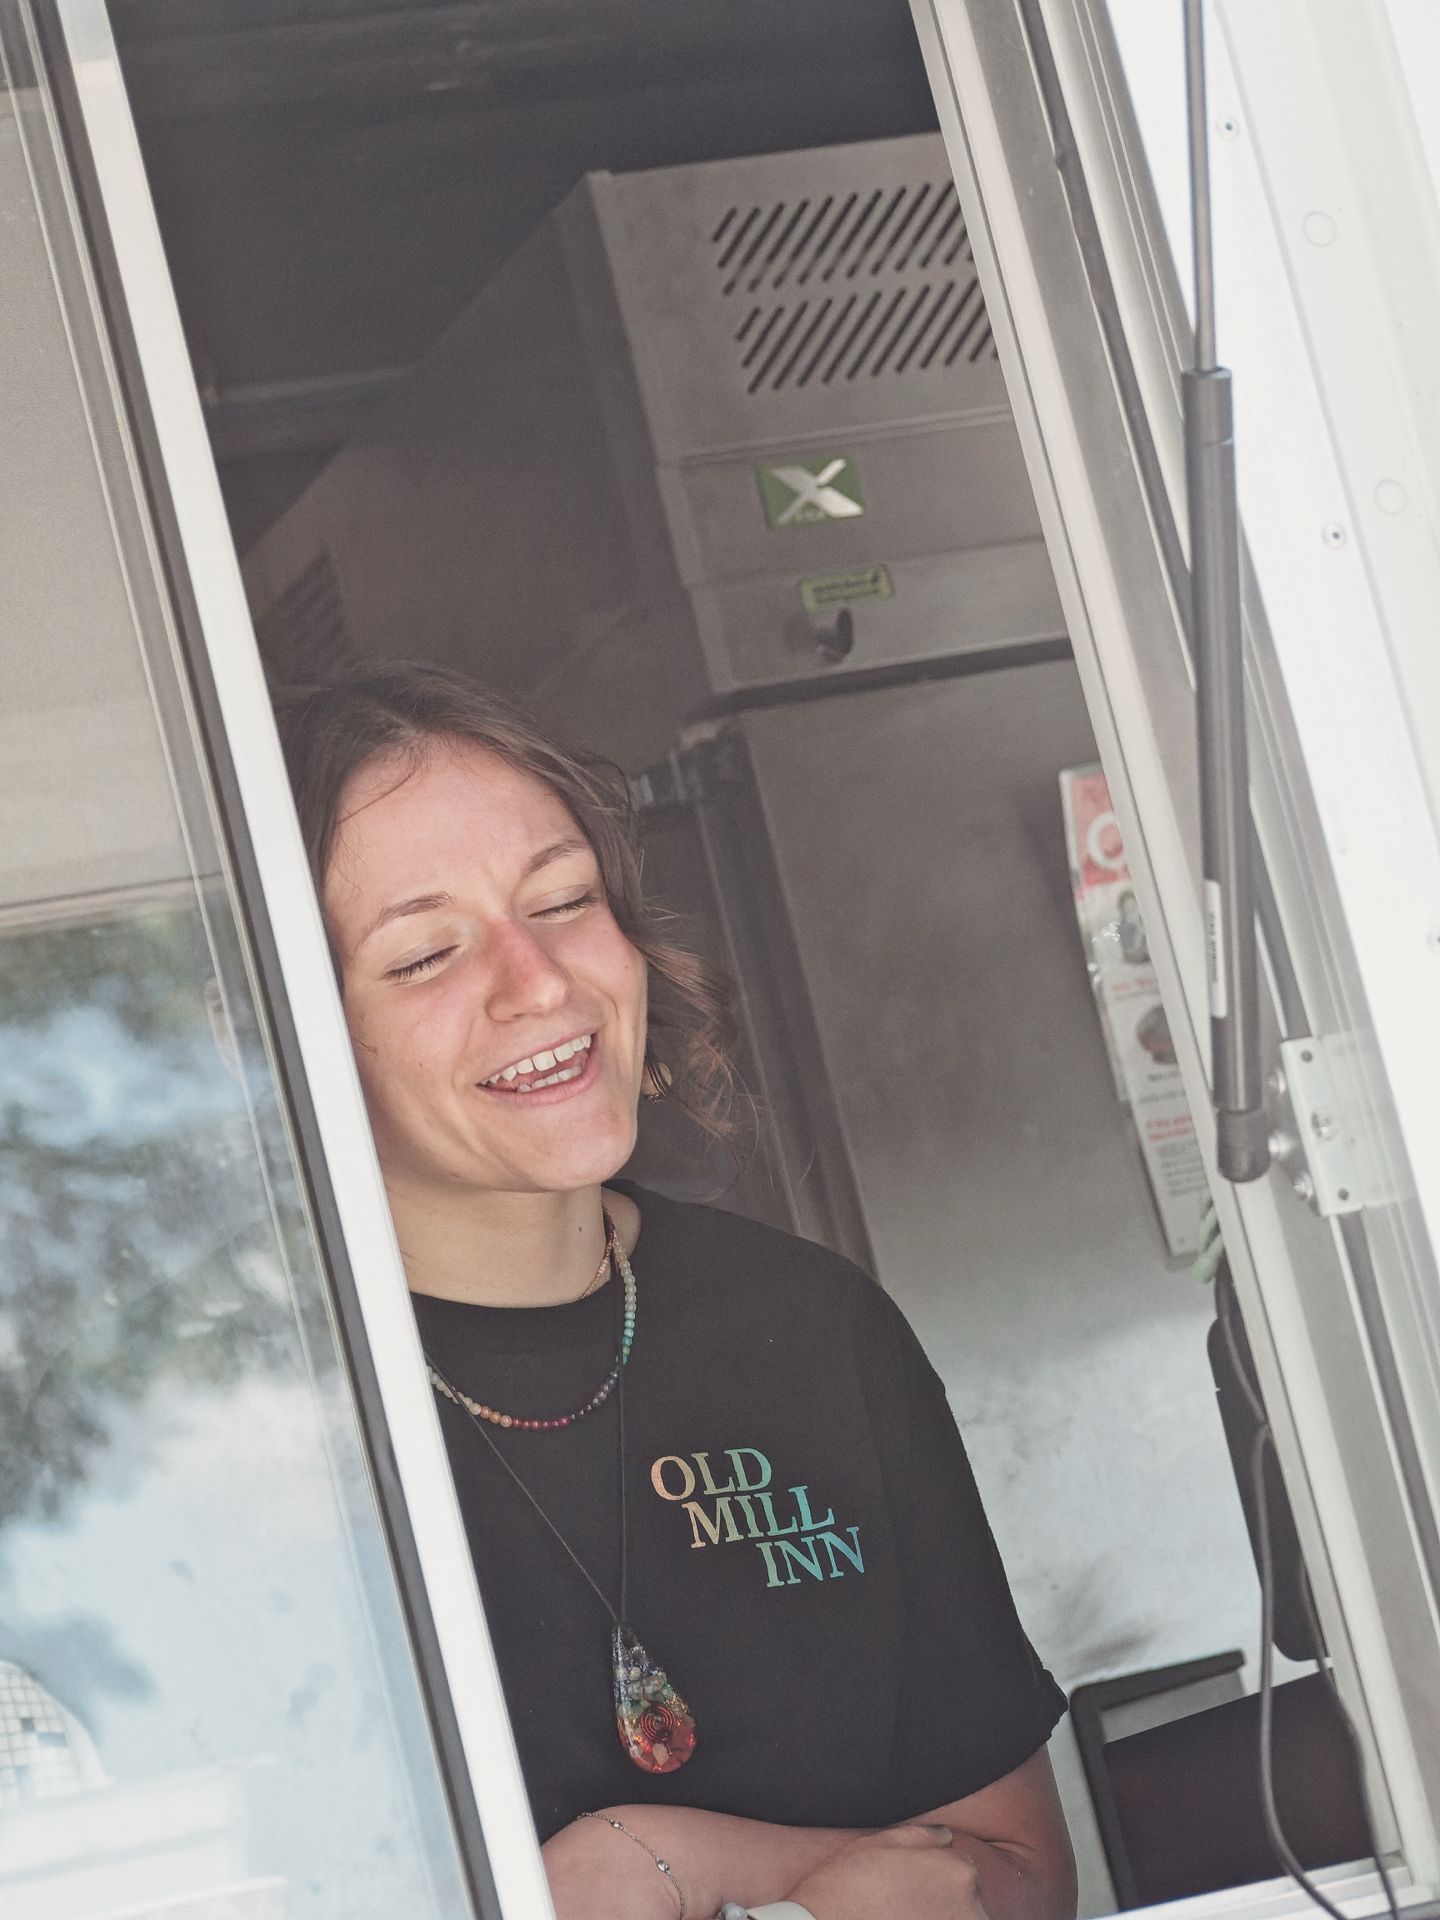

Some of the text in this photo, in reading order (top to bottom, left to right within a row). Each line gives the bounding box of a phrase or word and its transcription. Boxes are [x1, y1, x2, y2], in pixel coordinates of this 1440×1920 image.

[651, 1447, 772, 1501] OLD
[682, 1486, 834, 1548] MILL
[756, 1527, 864, 1587] INN
